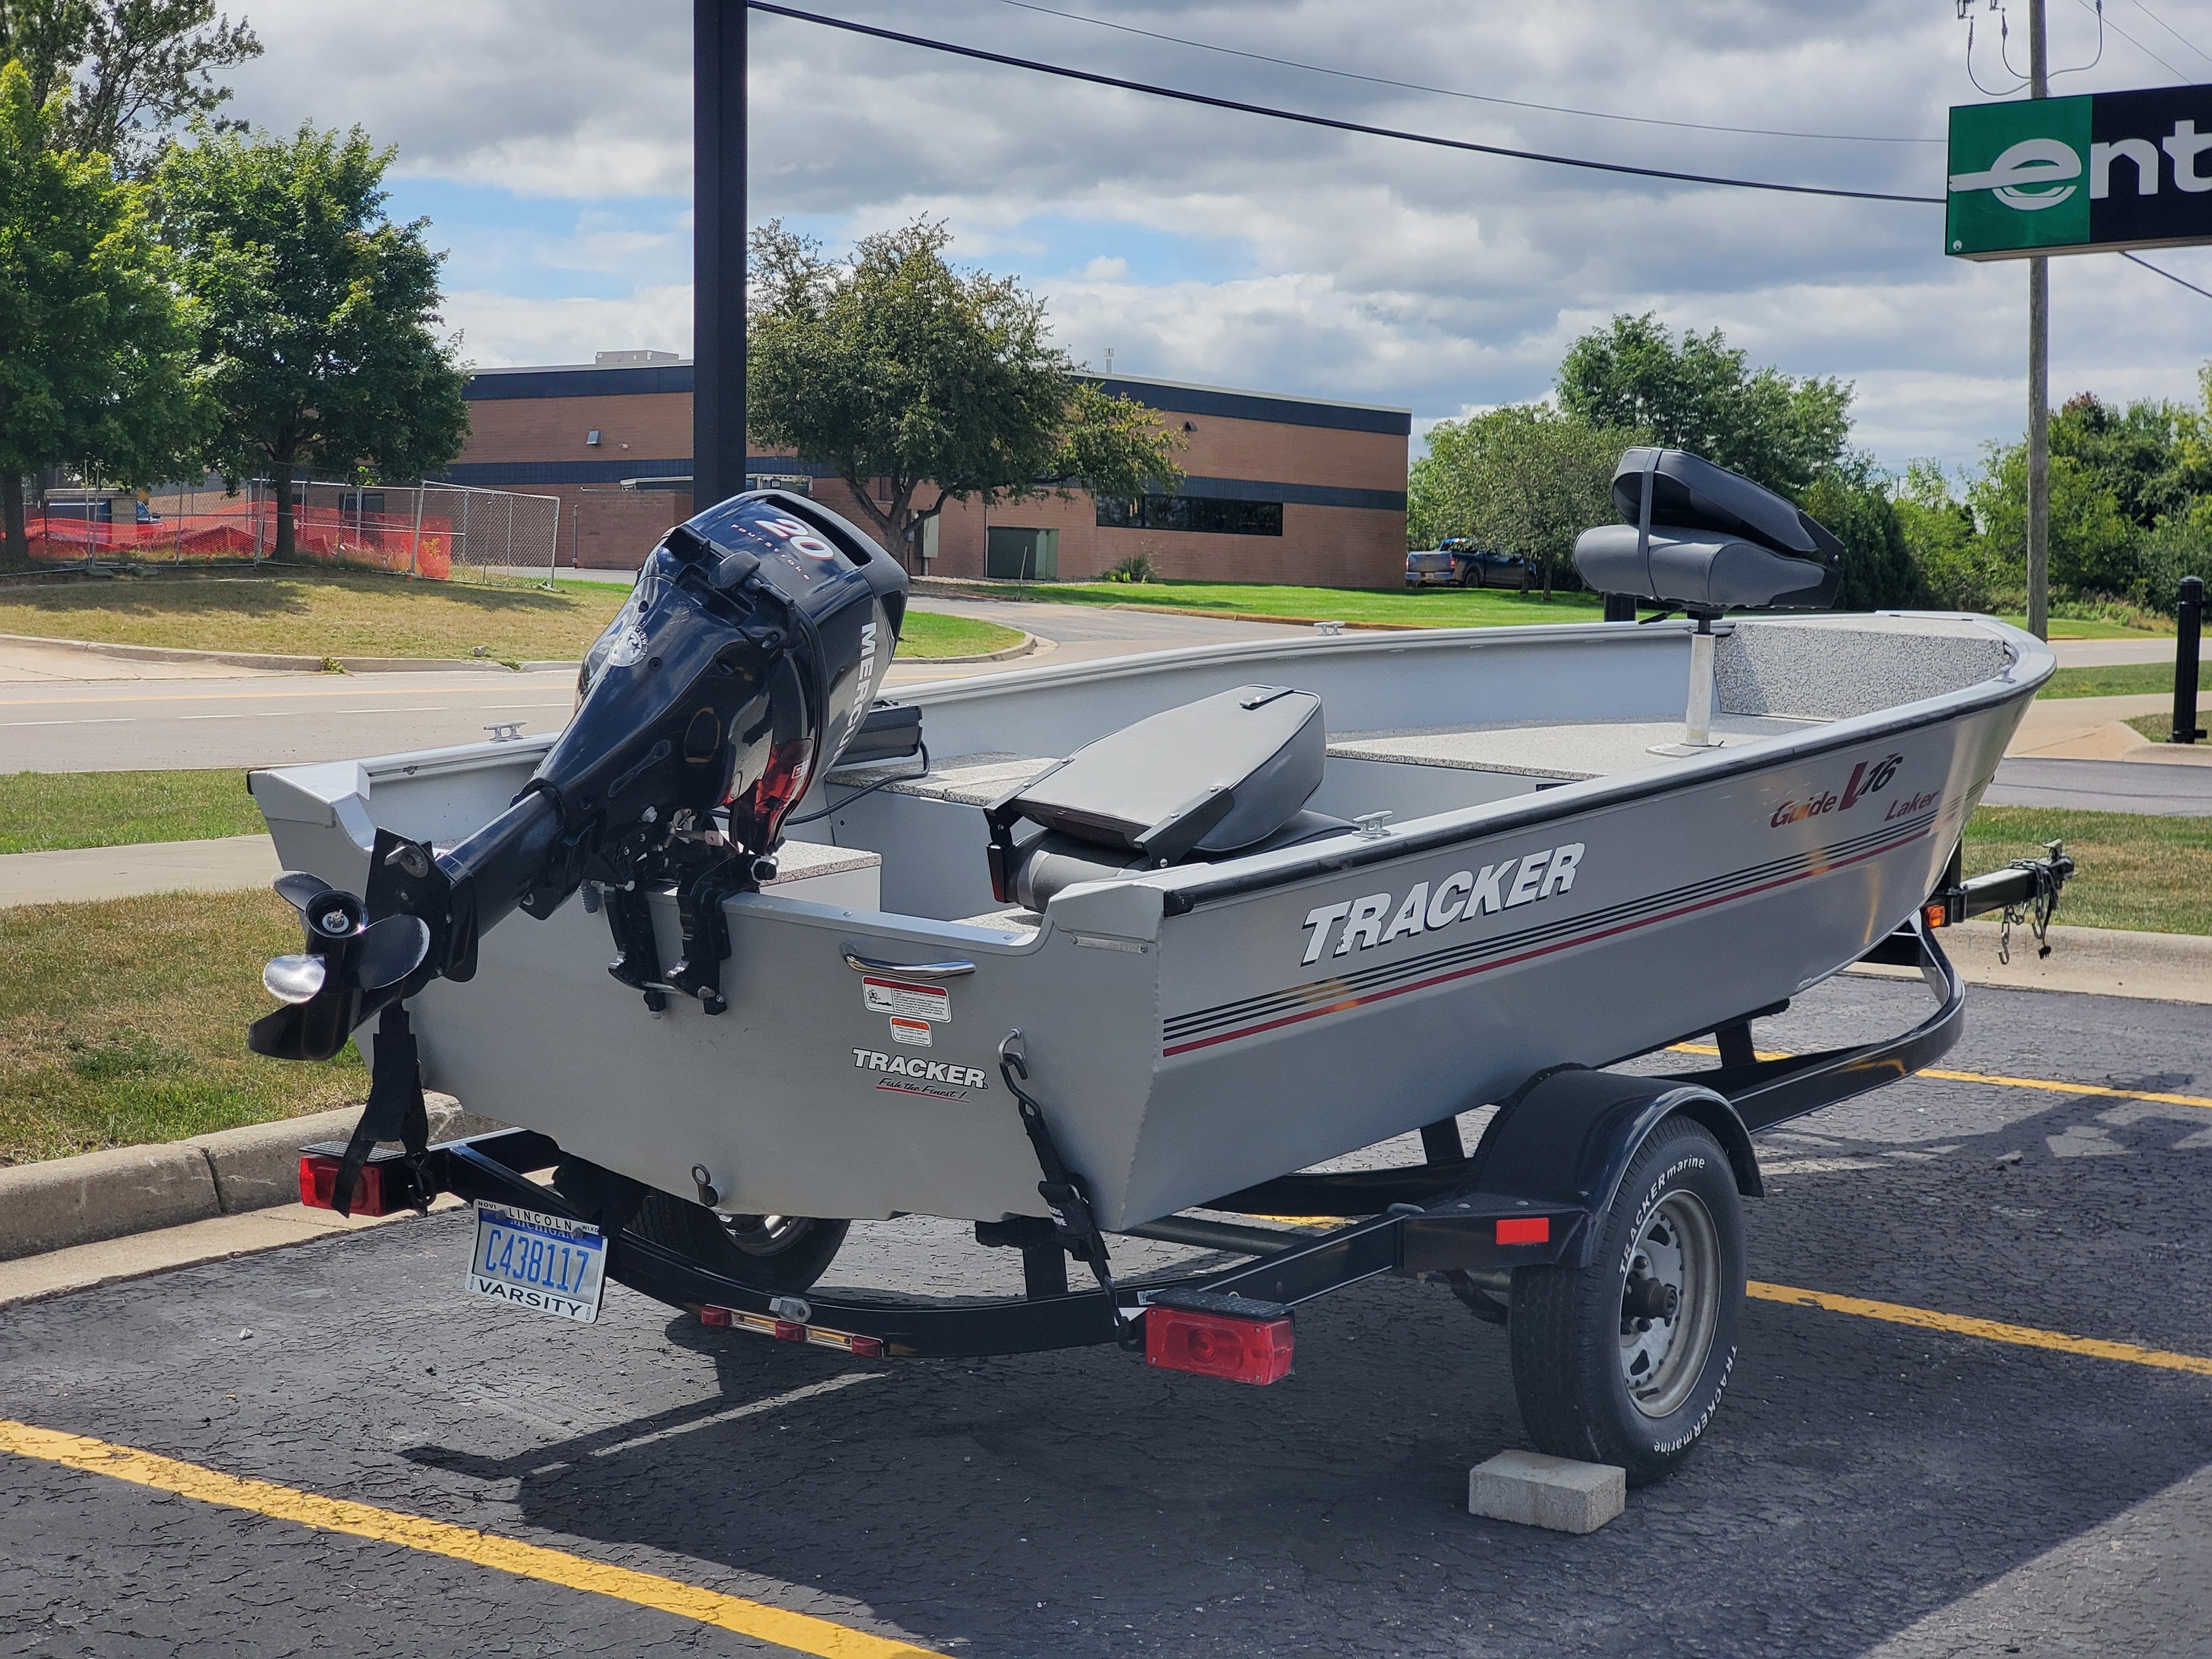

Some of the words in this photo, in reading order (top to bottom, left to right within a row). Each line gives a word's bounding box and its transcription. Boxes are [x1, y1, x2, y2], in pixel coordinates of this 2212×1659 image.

[754, 518, 834, 560] 20
[821, 622, 877, 778] MERCUR
[1771, 791, 1837, 827] Guide
[1884, 790, 1940, 821] Laker
[1300, 843, 1585, 967] TRACKER
[878, 1077, 902, 1090] Fish
[904, 1082, 921, 1092] the
[478, 1201, 496, 1209] NOVI
[509, 1207, 572, 1231] LINCOLN
[486, 1229, 589, 1294] C438117
[479, 1279, 582, 1316] VARSITY
